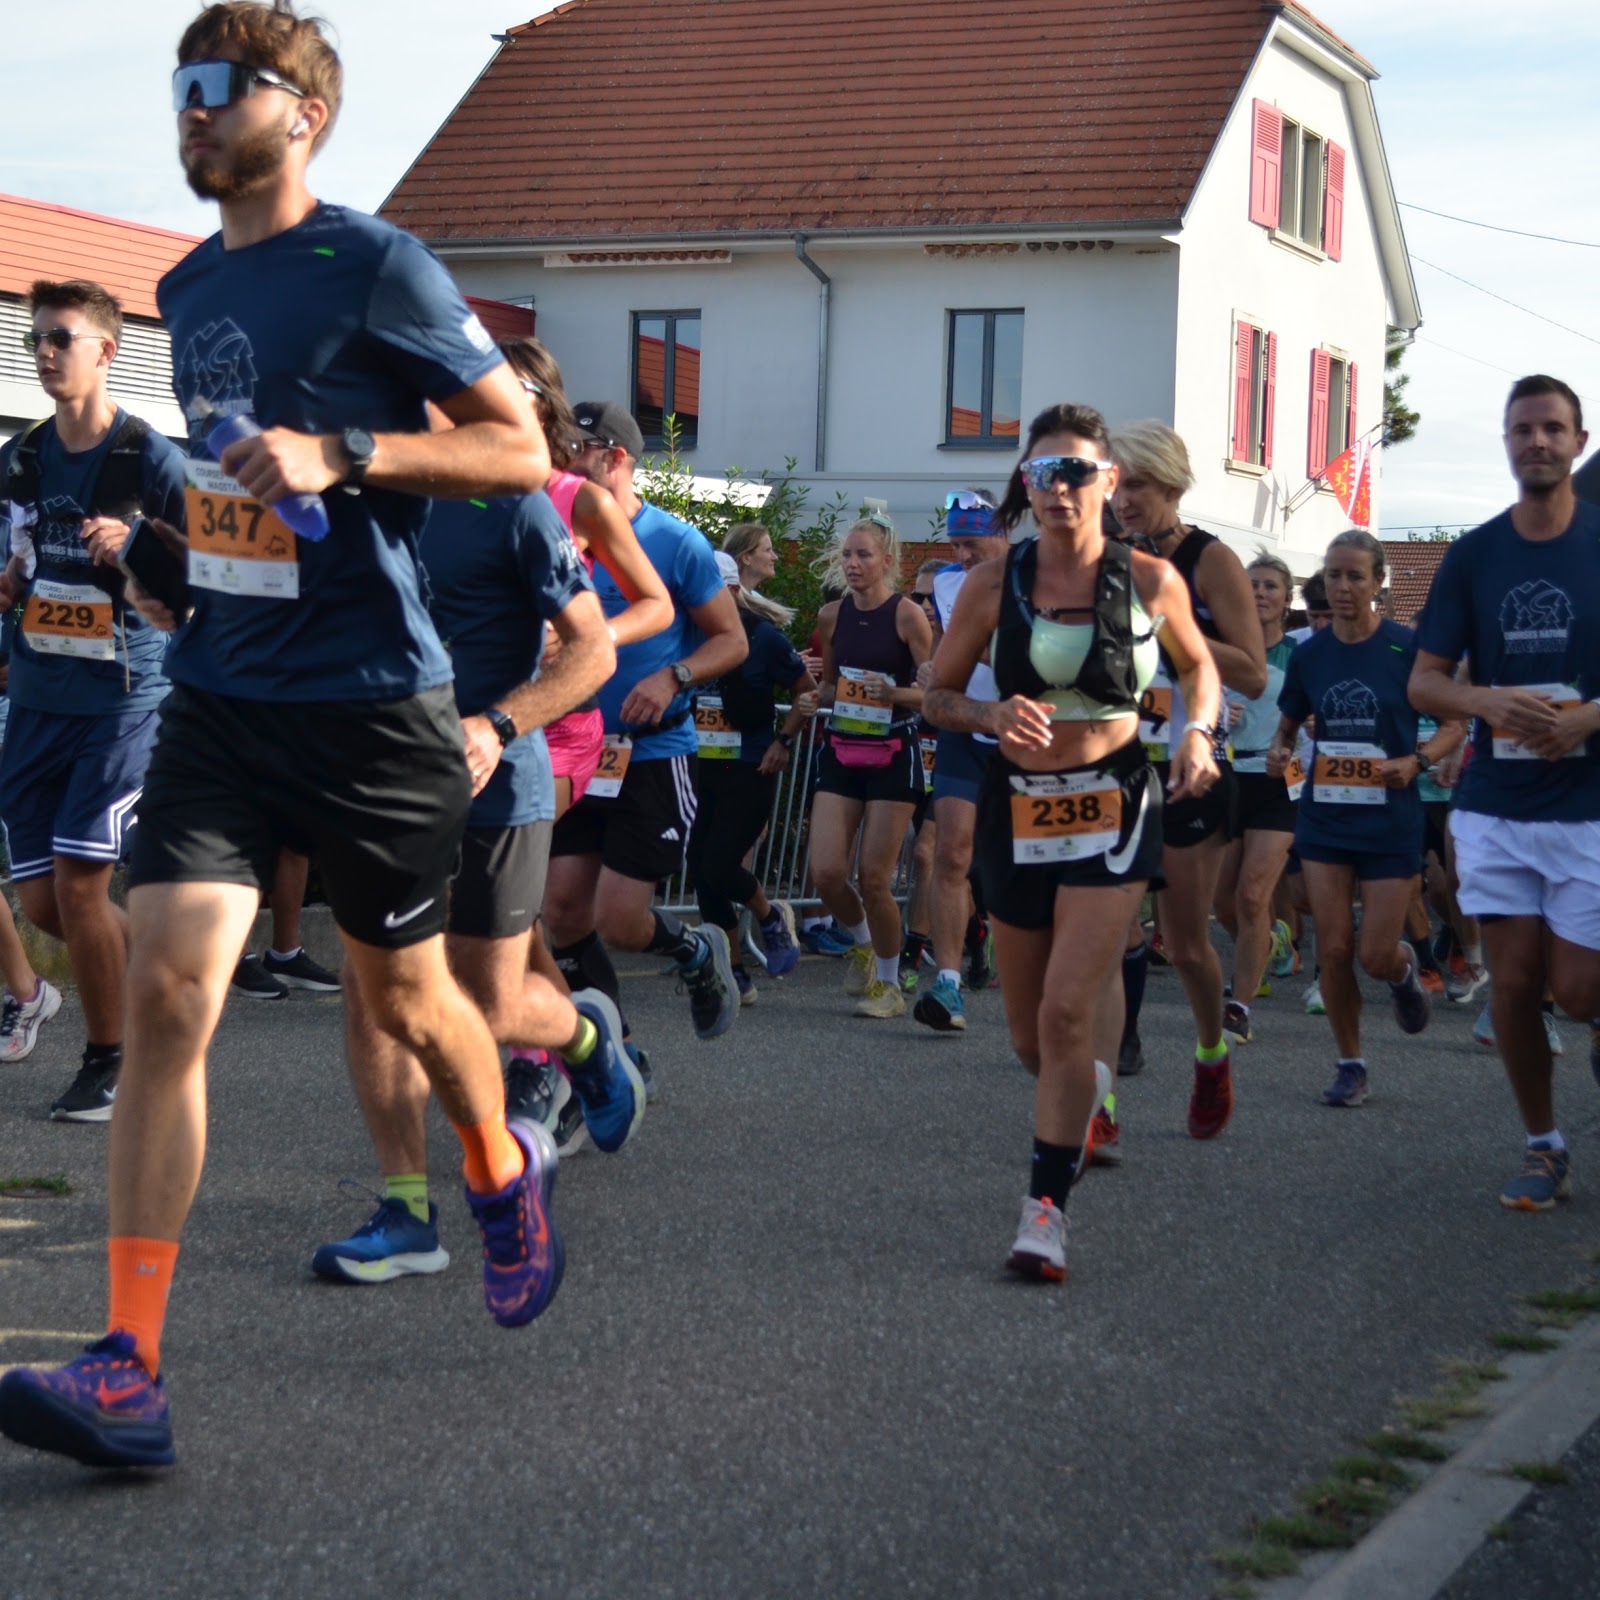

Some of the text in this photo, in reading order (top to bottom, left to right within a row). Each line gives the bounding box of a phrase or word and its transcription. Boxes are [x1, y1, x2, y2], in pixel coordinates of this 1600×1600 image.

[195, 467, 225, 480] COURSES
[200, 497, 265, 542] 347
[40, 583, 63, 593] COURSES
[48, 593, 82, 601] MAGSTATT
[38, 601, 95, 629] 229
[1325, 759, 1372, 779] 298
[1042, 784, 1086, 794] MAGSTATT
[1031, 795, 1101, 827] 238
